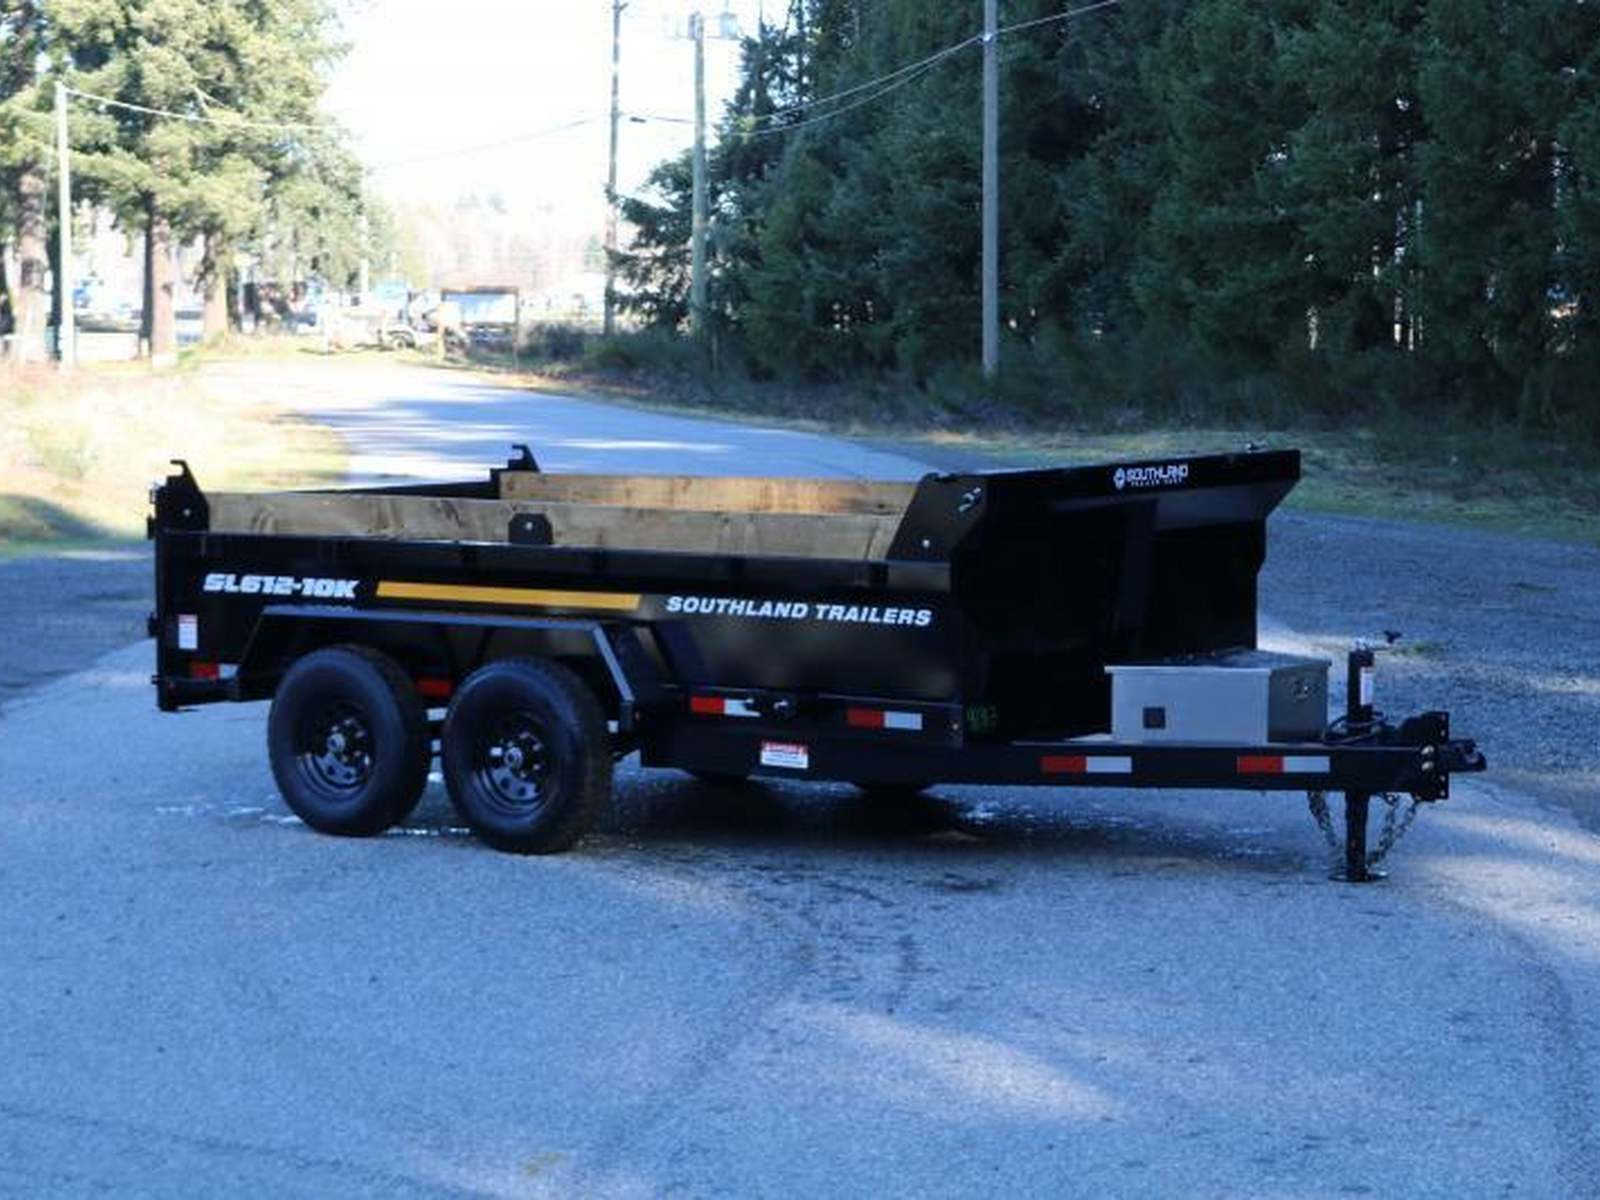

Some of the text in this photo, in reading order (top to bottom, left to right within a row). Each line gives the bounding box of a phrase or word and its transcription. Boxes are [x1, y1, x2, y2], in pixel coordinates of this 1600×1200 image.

[1126, 464, 1188, 482] SOUTHLAND
[203, 573, 359, 598] SL612-10K
[666, 596, 932, 626] SOUTHLAND TRAILERS
